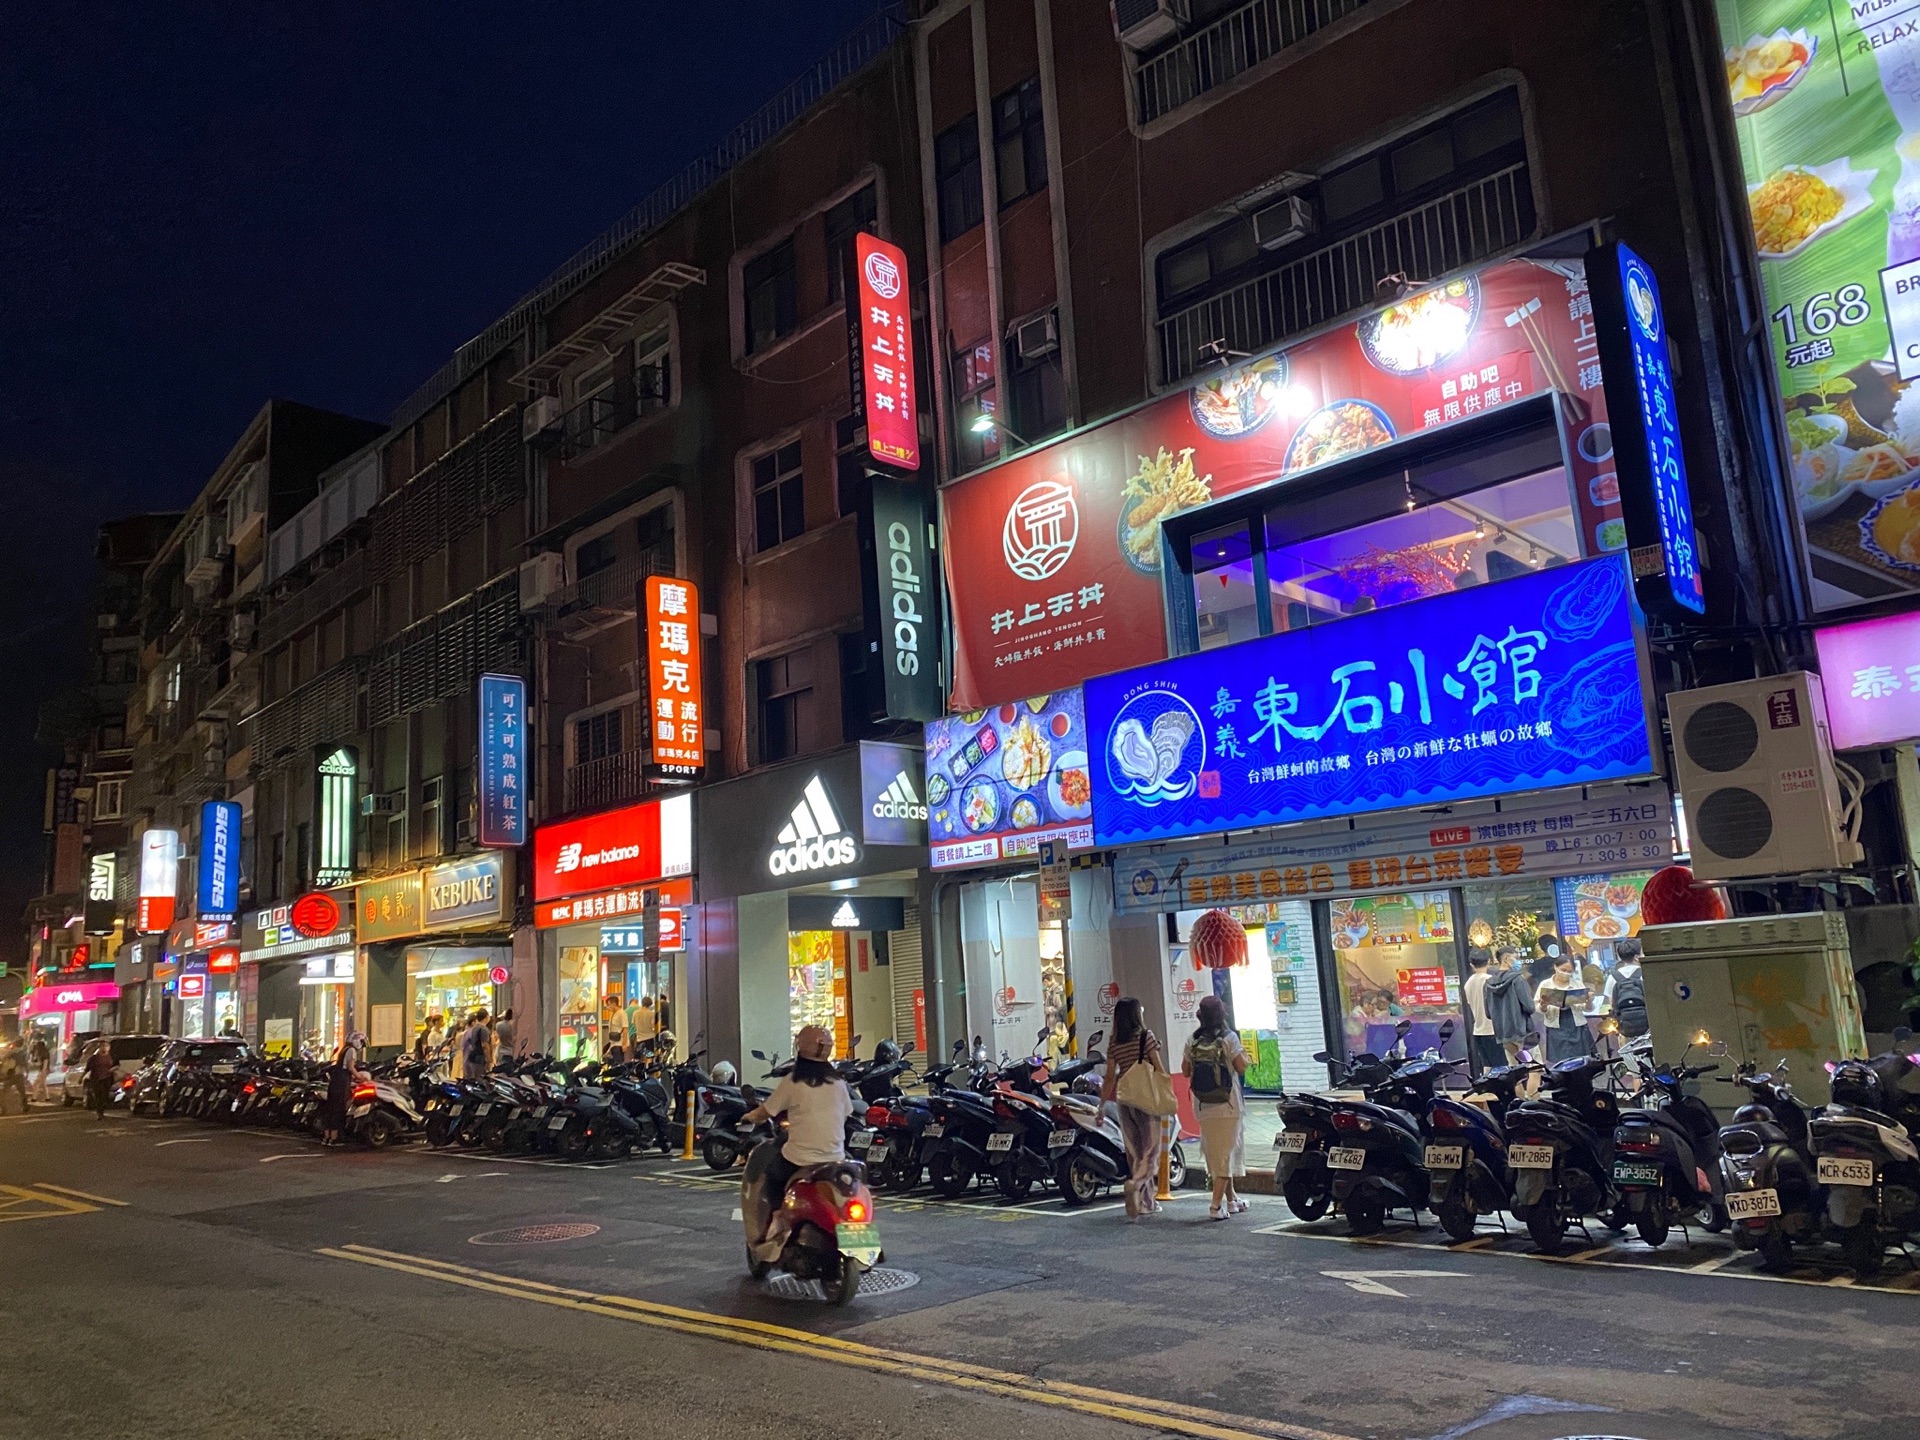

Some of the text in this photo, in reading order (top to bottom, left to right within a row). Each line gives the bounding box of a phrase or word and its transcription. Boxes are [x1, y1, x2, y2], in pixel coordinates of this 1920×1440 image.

[1857, 19, 1919, 55] RELAX
[1772, 283, 1871, 345] 168
[870, 306, 896, 414] 井上天丼
[1786, 337, 1835, 369] 元起
[1441, 364, 1500, 400] 自助吧
[1423, 380, 1524, 428] 無限供應中
[888, 521, 923, 677] adidas
[991, 582, 1105, 635] 井上天丼
[658, 583, 691, 694] 摩瑪克
[1054, 621, 1082, 633] TENDON
[1123, 680, 1178, 701] DONG SHIH
[1247, 625, 1549, 754] 東石小館
[656, 698, 675, 742] 運動
[680, 700, 699, 744] 流行
[1210, 686, 1247, 759] 嘉義
[318, 765, 356, 775] adidas
[502, 693, 517, 832] 可不可熟成紅茶
[661, 764, 697, 775] SPORT
[872, 801, 928, 821] adidas
[1543, 803, 1657, 831] 每周二三五六日
[1435, 830, 1464, 843] LIVE
[1477, 821, 1538, 840] 演唱時段
[211, 804, 229, 909] SKECHERS
[582, 852, 601, 867] new
[601, 844, 640, 863] balance
[768, 835, 857, 877] adidas
[936, 843, 993, 863] 用餐請上二樓
[90, 852, 116, 901] VANS
[430, 874, 494, 911] KEBUKE
[1186, 862, 1336, 905] 音樂美食結合
[573, 1014, 597, 1025] FILA
[1328, 1151, 1363, 1166] NCT-6682
[1427, 1153, 1460, 1165] 136-MWX
[1510, 1151, 1551, 1164] MUY-2885
[1819, 1164, 1871, 1180] MCR-6533
[1729, 1195, 1778, 1214] MXD-3875
